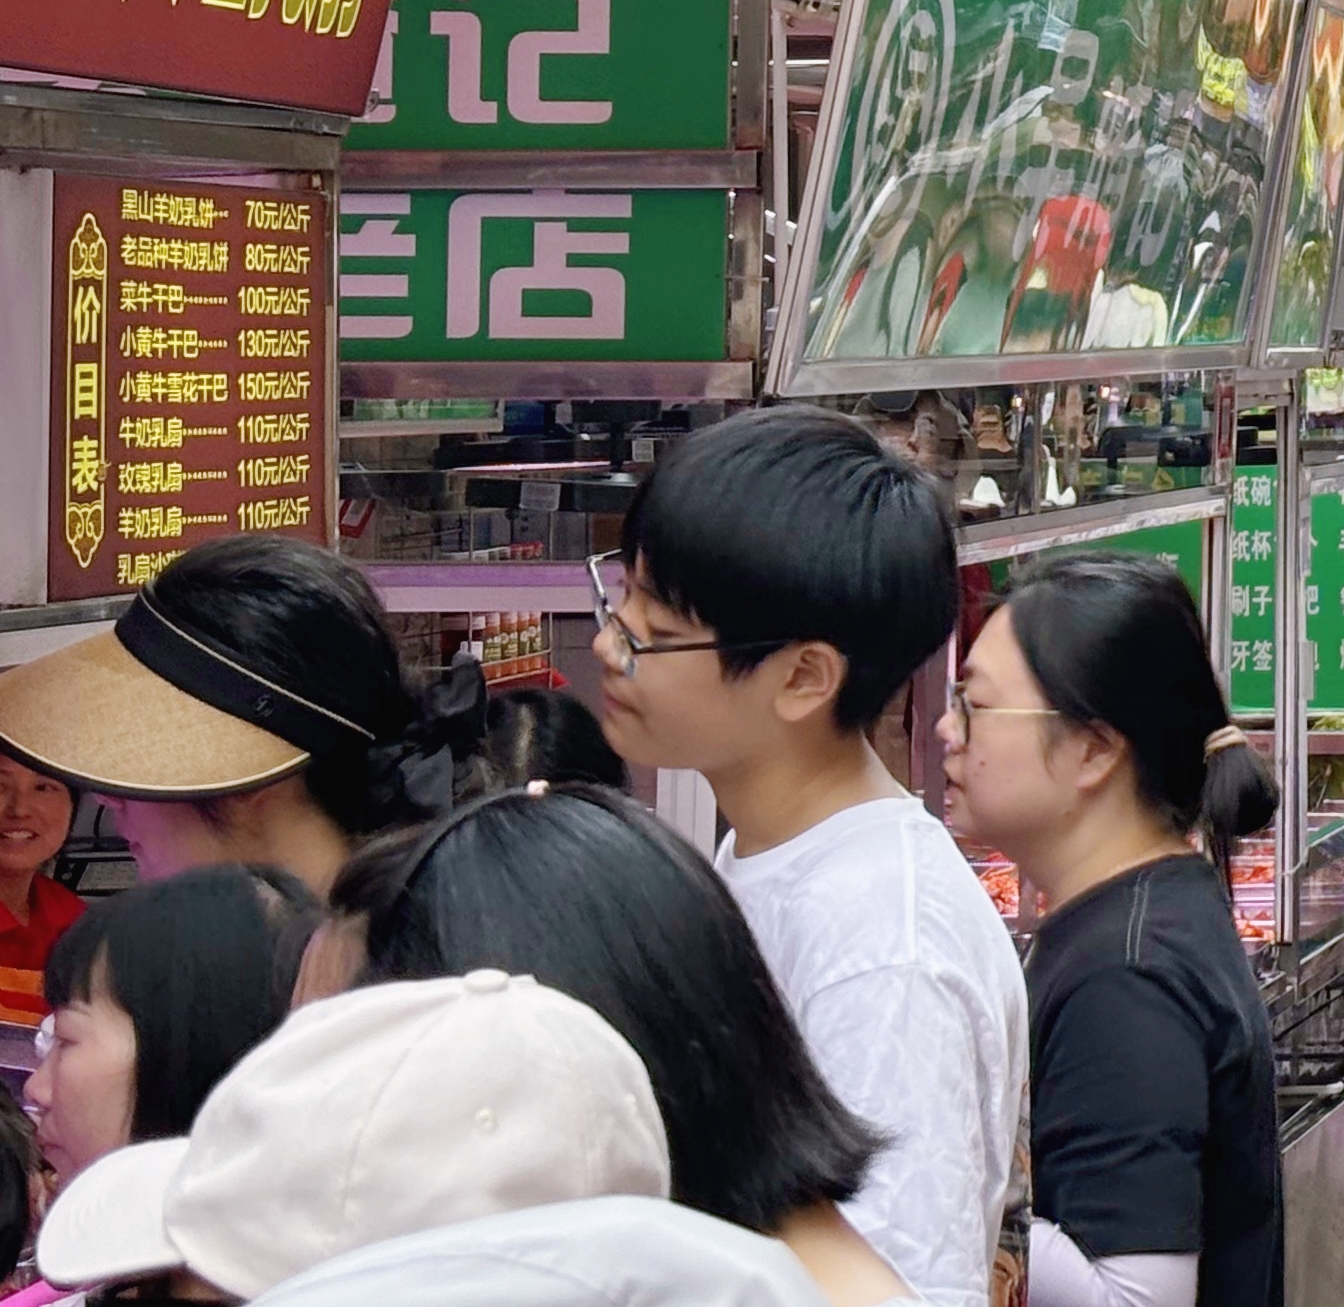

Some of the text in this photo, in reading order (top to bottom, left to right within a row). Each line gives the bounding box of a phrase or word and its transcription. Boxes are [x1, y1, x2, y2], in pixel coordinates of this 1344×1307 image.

[245, 200, 311, 232] 70元/公斤
[245, 245, 311, 274] 80元/公斤
[238, 287, 311, 316] 100元/公斤
[238, 330, 311, 359] 130元/公斤
[72, 286, 102, 494] 价目表
[238, 371, 311, 402] 150元/公斤
[238, 413, 311, 444] 110元/公斤
[238, 455, 311, 487] 110元/公斤
[238, 497, 311, 530] 110元/公斤
